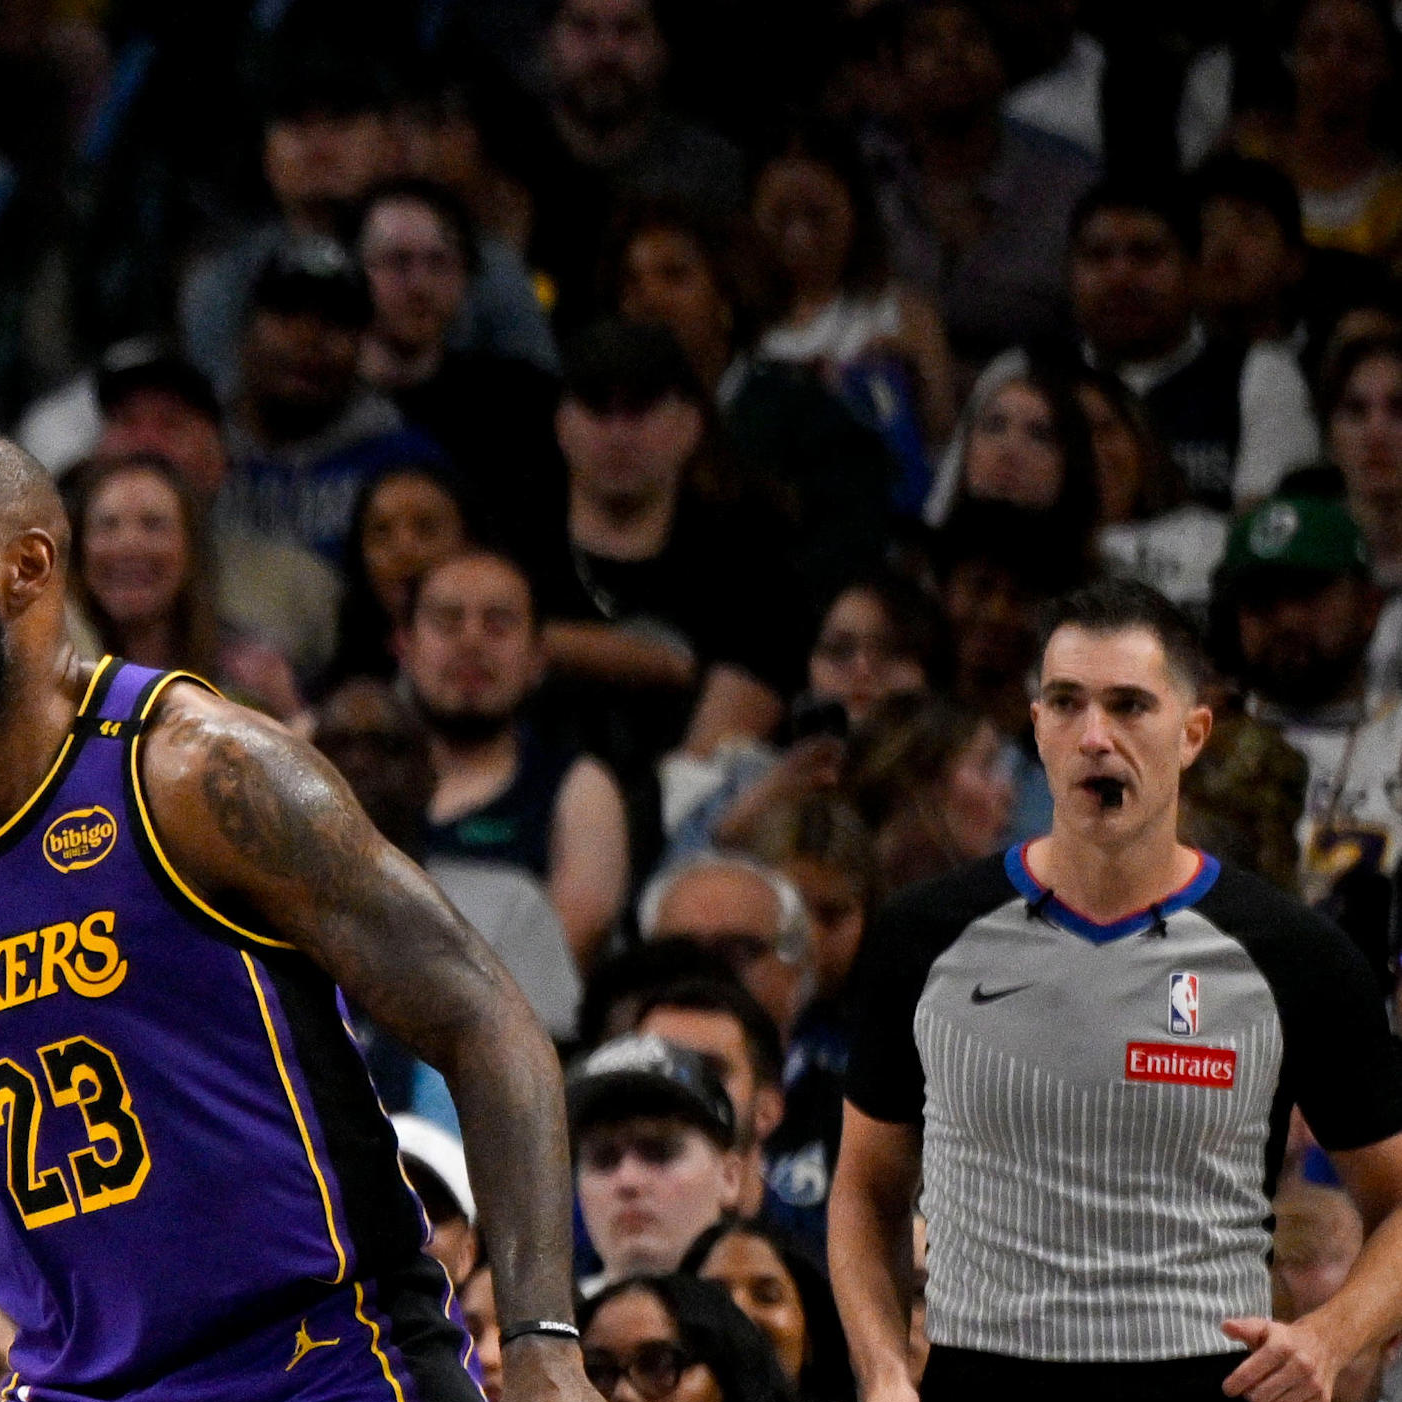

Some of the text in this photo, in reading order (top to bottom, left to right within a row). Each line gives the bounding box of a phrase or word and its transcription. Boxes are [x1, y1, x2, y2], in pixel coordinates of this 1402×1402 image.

[99, 720, 122, 737] 44
[49, 822, 113, 853] bibigo
[1129, 1047, 1233, 1081] Emirates
